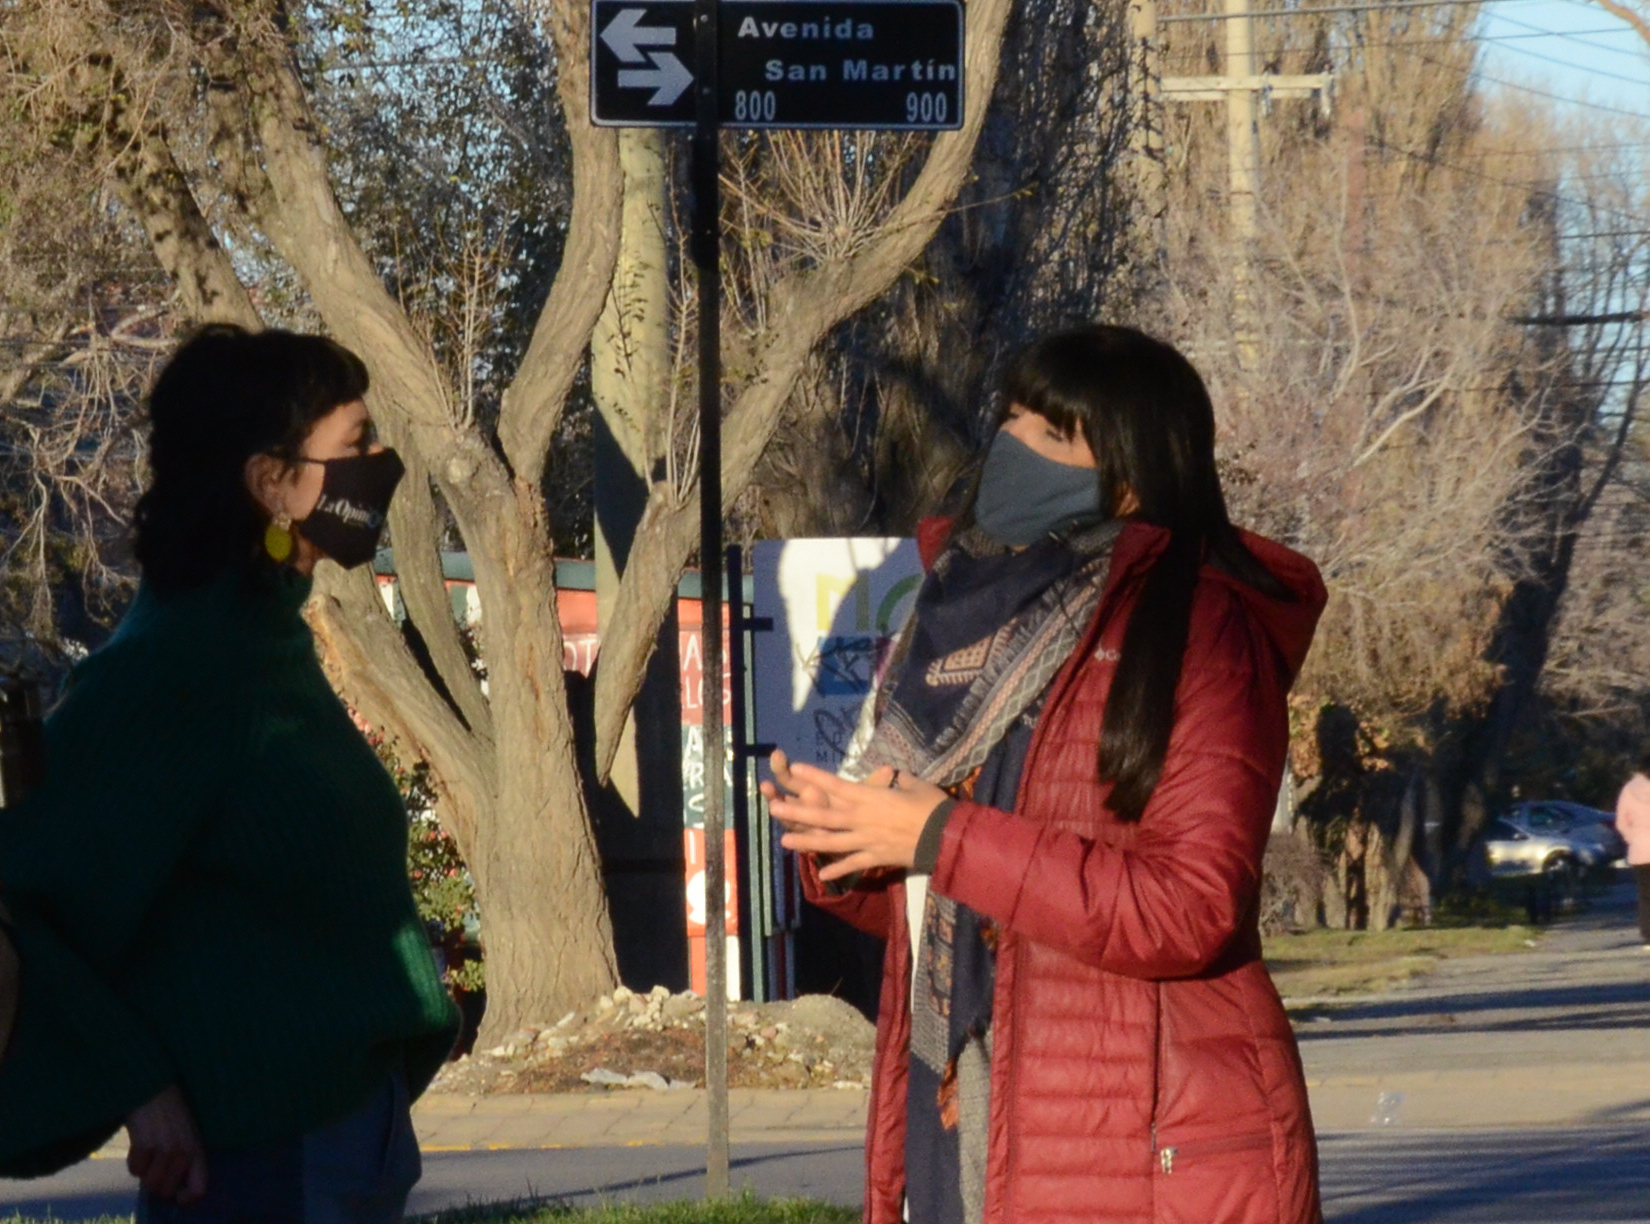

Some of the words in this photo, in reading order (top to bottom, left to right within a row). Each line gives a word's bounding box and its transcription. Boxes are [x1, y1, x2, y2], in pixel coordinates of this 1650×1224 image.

[737, 16, 874, 39] Avenida
[765, 58, 827, 81] San
[843, 58, 956, 81] Martín
[735, 90, 776, 121] 800
[906, 92, 947, 123] 900
